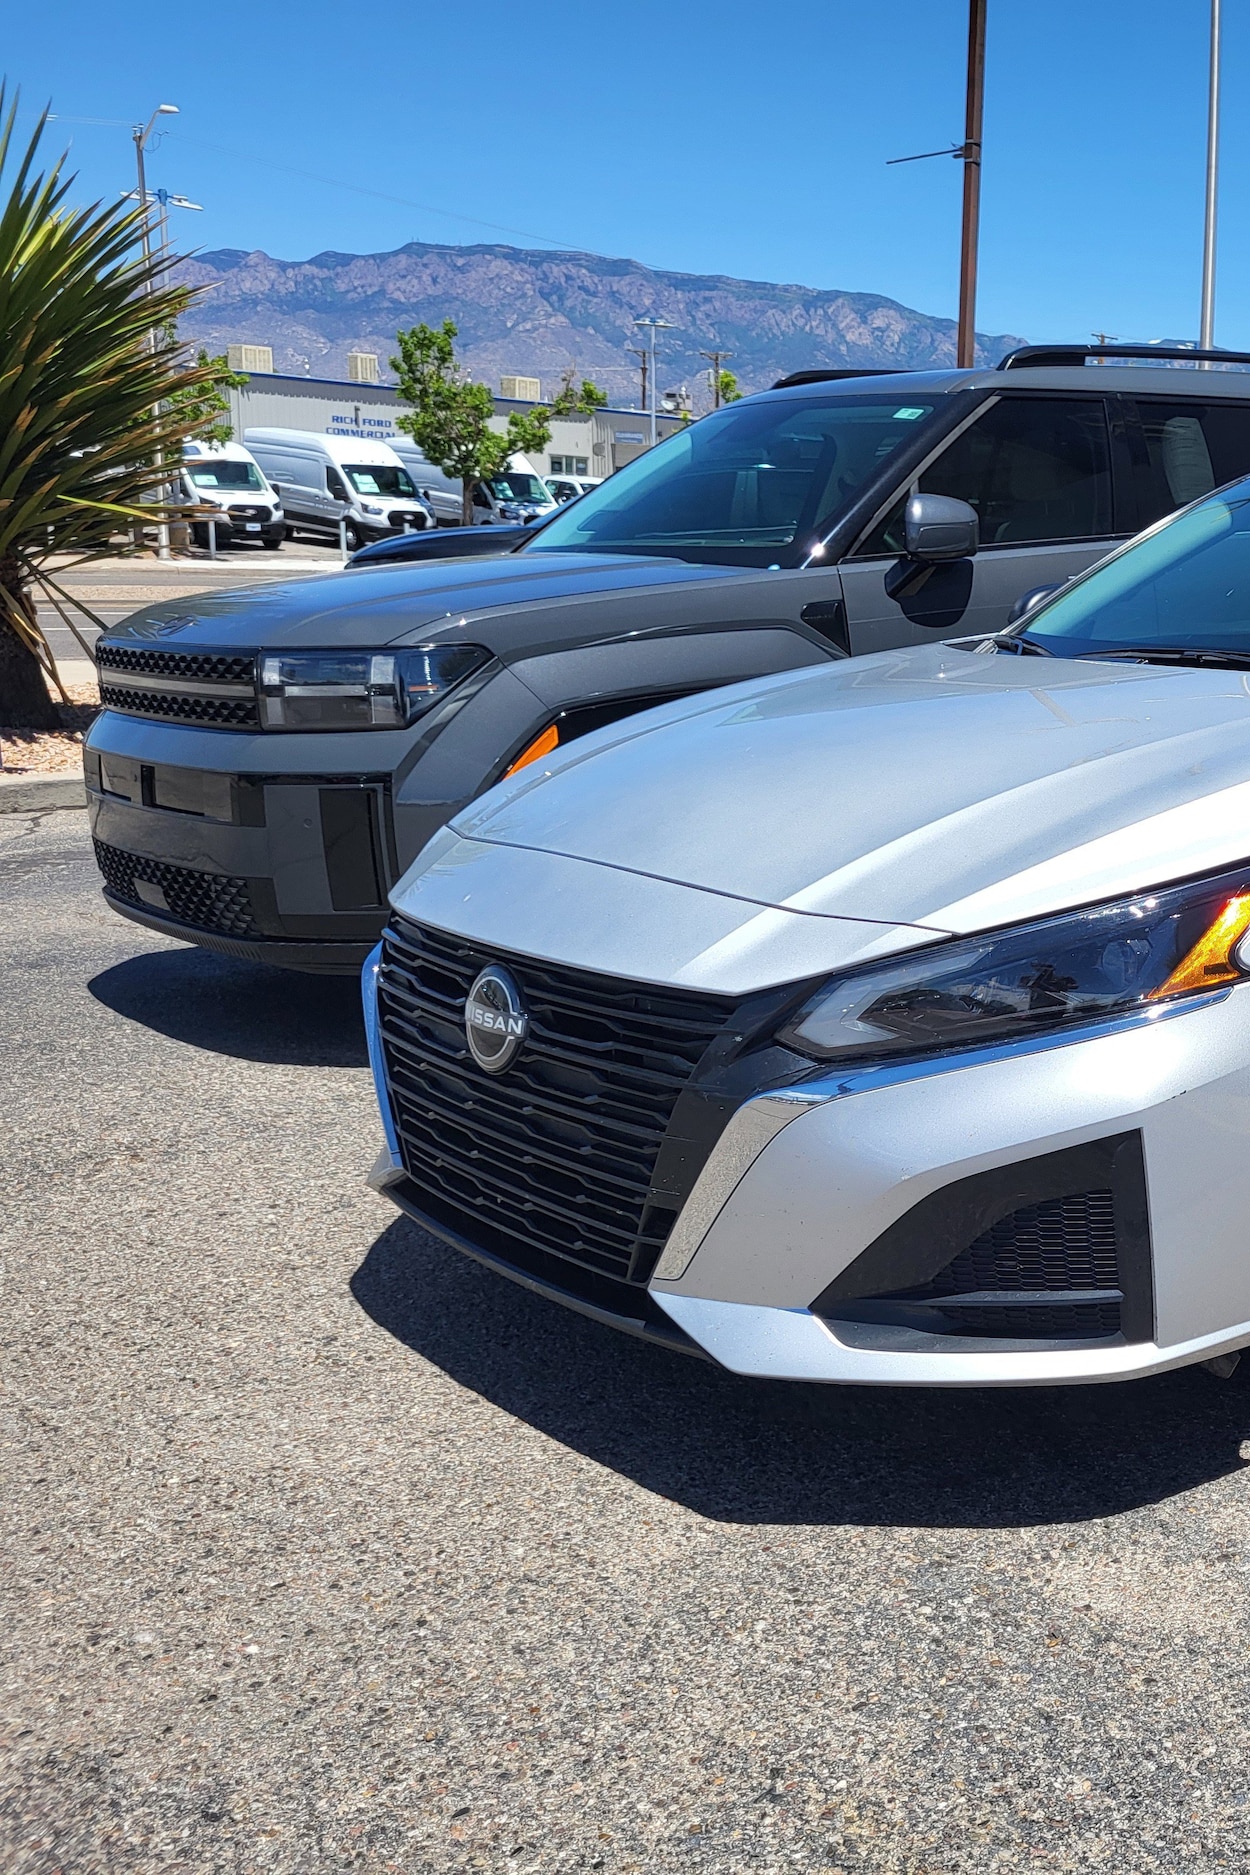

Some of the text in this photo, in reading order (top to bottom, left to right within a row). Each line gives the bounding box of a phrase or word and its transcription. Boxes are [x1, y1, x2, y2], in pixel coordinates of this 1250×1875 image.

[332, 415, 392, 428] RICH FORD
[467, 1003, 523, 1035] NISSAN
